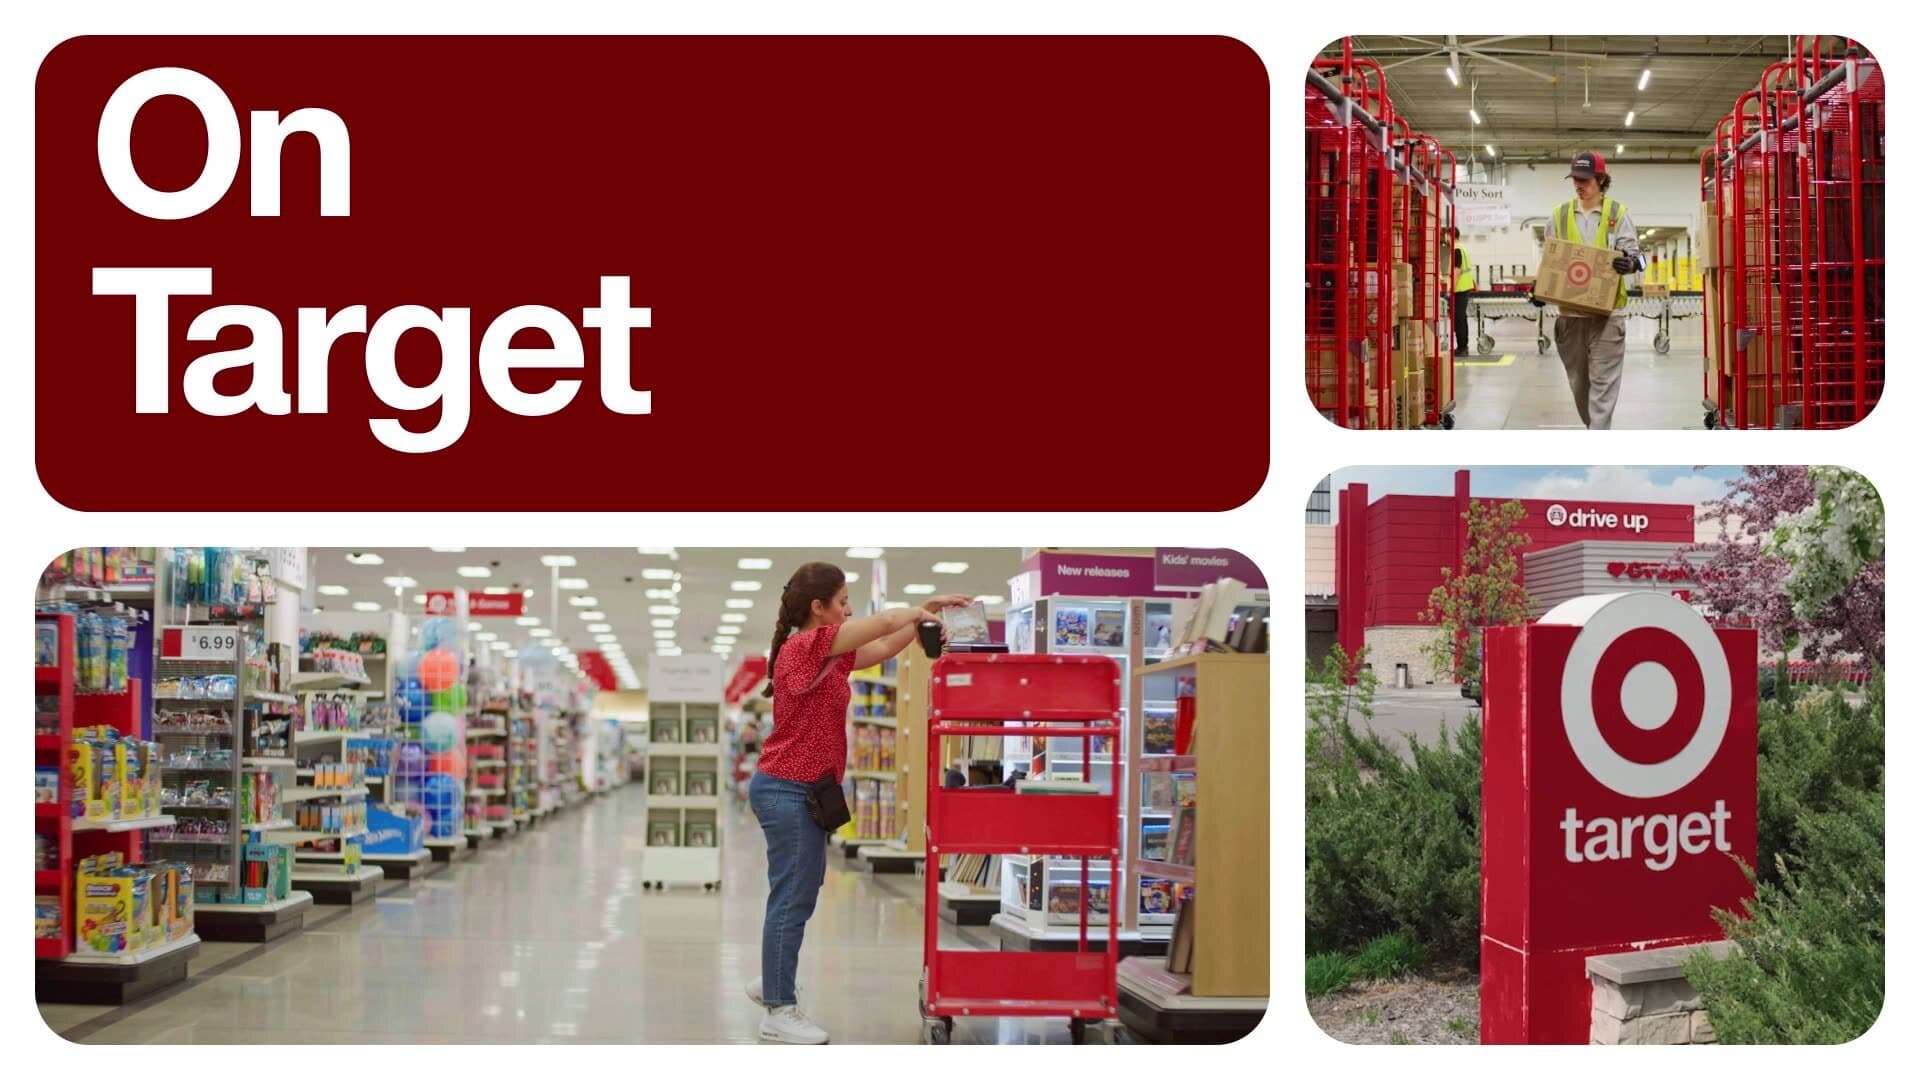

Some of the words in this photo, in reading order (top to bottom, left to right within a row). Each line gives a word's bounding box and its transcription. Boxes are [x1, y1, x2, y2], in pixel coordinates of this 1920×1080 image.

[1455, 188, 1478, 200] Poly
[1481, 189, 1503, 199] Sort
[1569, 508, 1618, 528] drive
[1623, 514, 1649, 533] up
[1162, 554, 1189, 566] Kids'
[1190, 556, 1229, 567] movies
[1057, 564, 1083, 576] New
[1084, 565, 1130, 578] releases
[1560, 799, 1732, 871] target
